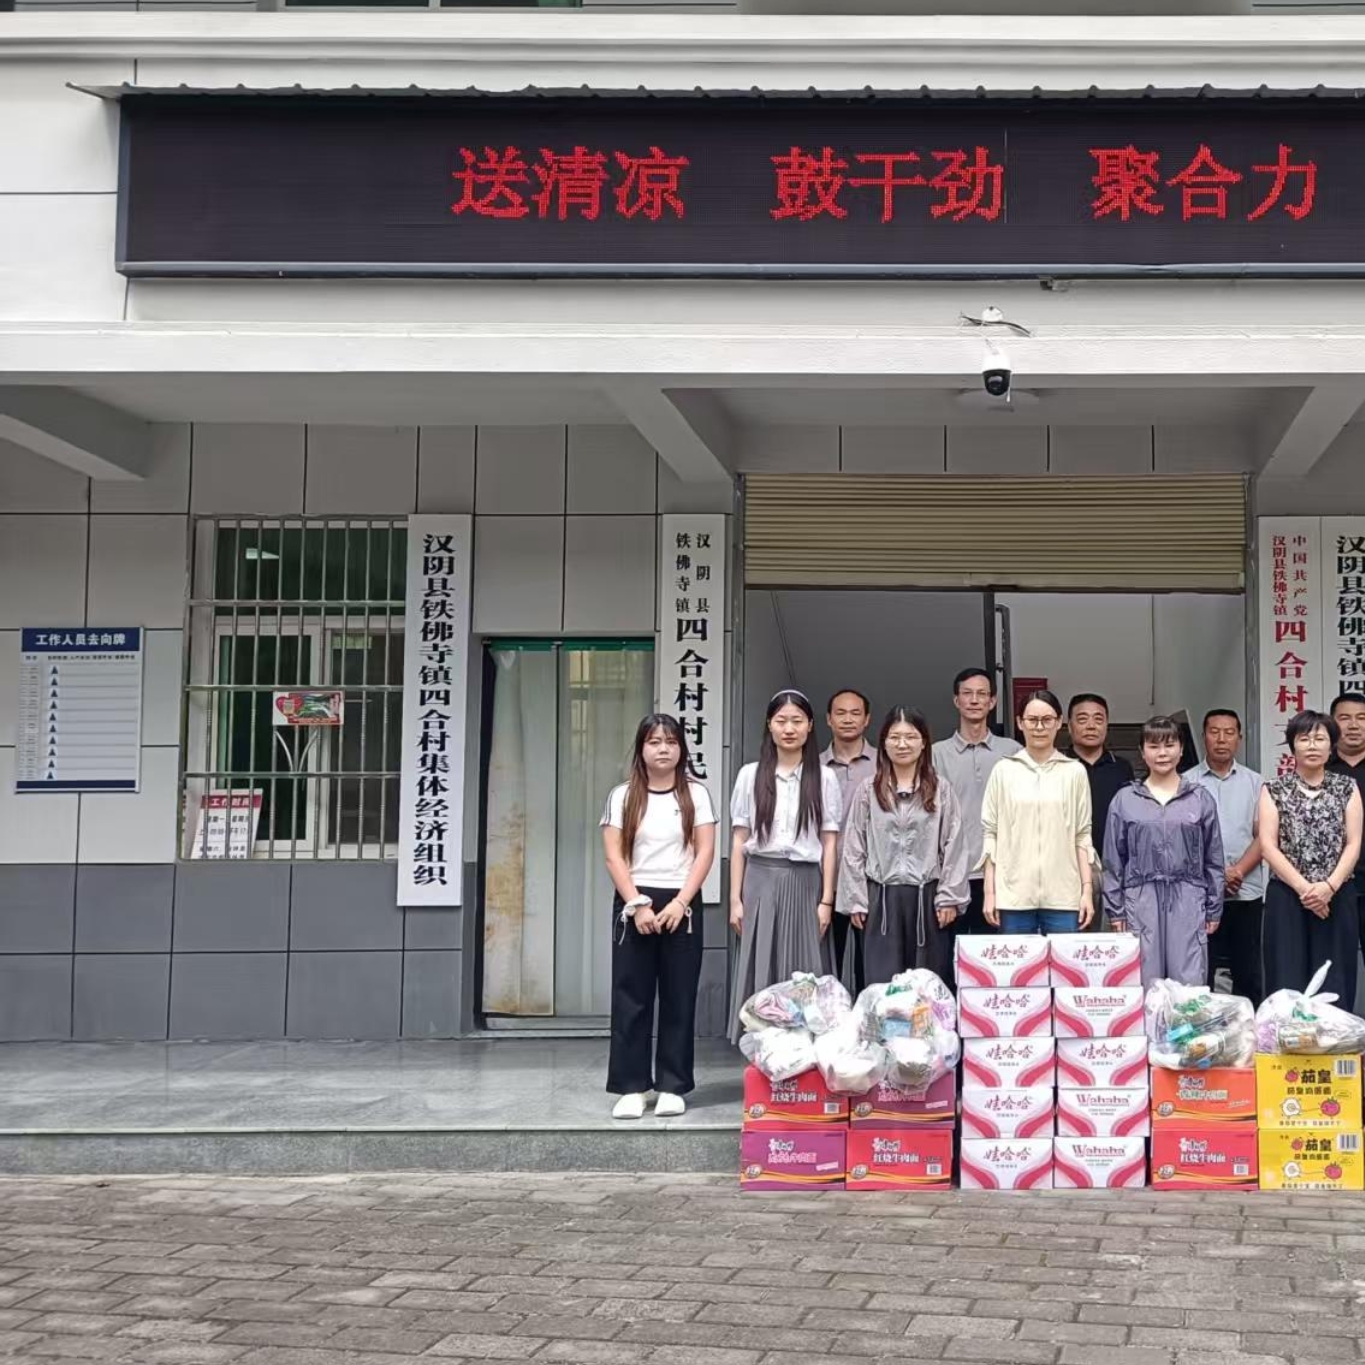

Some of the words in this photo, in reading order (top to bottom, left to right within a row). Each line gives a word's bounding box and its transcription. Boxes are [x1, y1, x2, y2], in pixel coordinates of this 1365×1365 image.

[452, 145, 688, 221] 送清凉
[771, 145, 1004, 222] 鼓干劲
[1089, 145, 1317, 221] 聚合力
[1272, 535, 1288, 616] 汉阴县铁佛寺镇
[1292, 535, 1308, 617] 中国共产党
[35, 633, 126, 646] 工作人员去向牌
[413, 534, 456, 886] 汉阴县铁佛寺镇四合村集体经济组织
[981, 944, 1029, 959] 娃哈哈
[1073, 945, 1120, 960] 娃哈哈
[983, 993, 1030, 1008] 娃哈哈
[986, 1044, 1033, 1059] 娃哈哈
[1080, 1044, 1126, 1059] 娃哈哈
[1301, 1069, 1332, 1083] 茄皇
[985, 1095, 1032, 1110] 娃哈哈
[1305, 1139, 1332, 1151] 茄皇
[983, 1146, 1030, 1161] 娃哈哈
